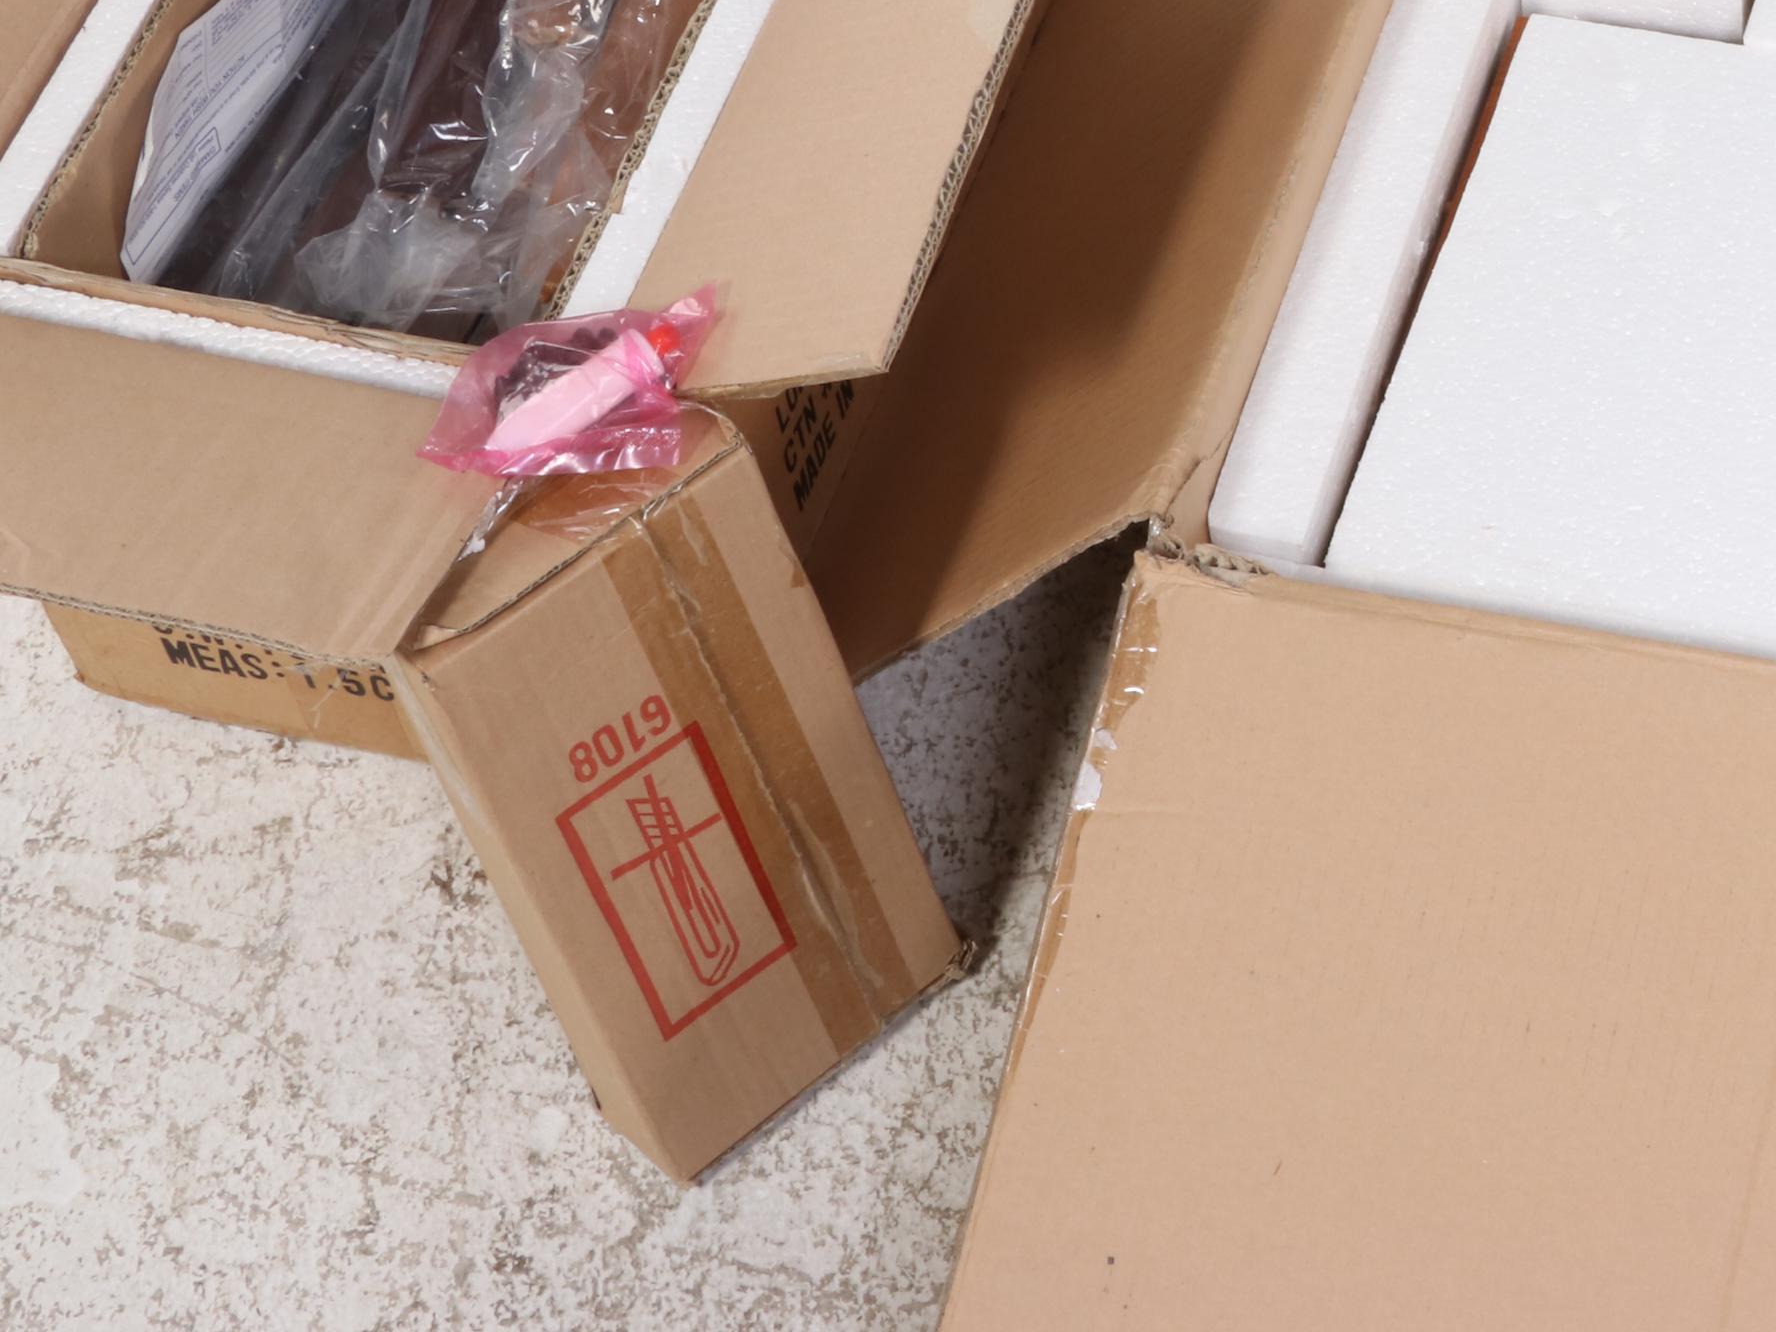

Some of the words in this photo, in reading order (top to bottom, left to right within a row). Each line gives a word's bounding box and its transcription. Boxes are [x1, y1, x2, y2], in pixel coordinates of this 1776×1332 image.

[783, 395, 817, 473] CTN
[793, 412, 836, 512] MADE
[568, 694, 672, 783] 6108
